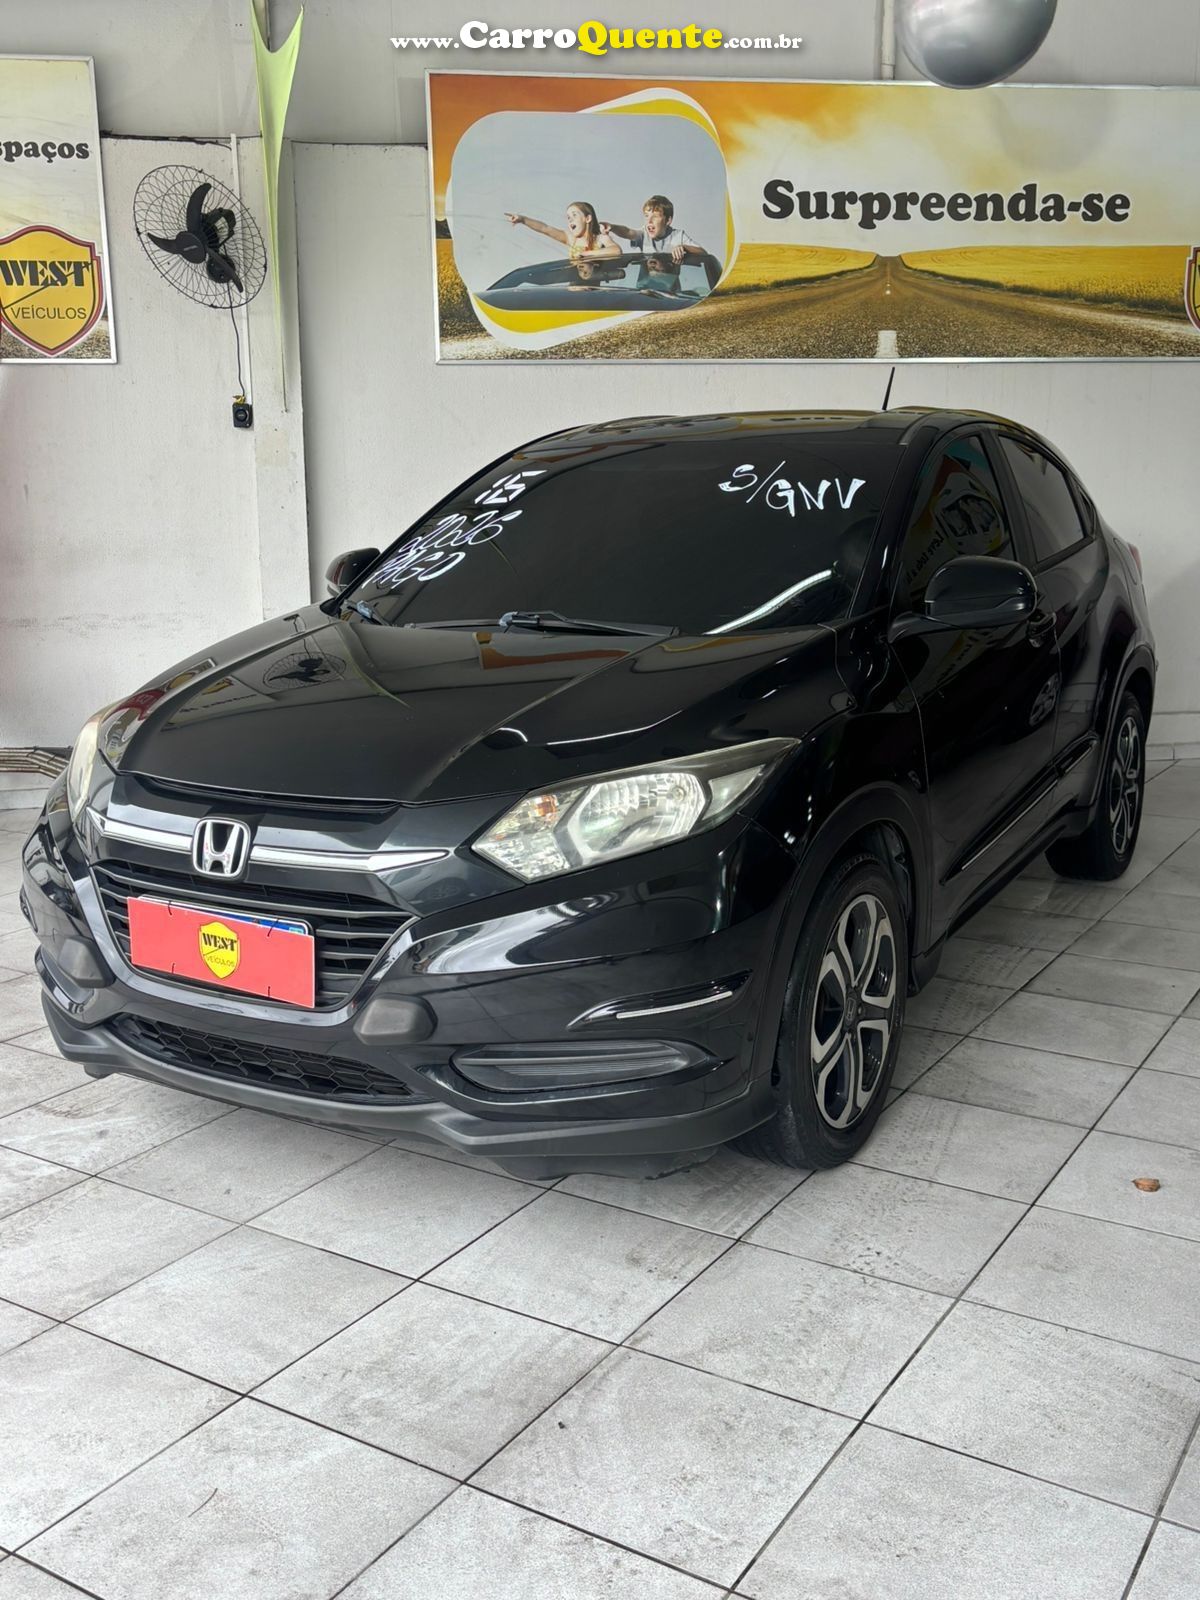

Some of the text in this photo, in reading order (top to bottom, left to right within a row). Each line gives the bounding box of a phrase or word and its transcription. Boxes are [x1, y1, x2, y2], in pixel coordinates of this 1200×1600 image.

[762, 179, 1131, 230] Surpreenda-se
[0, 259, 92, 287] WEST
[10, 305, 87, 320] VEÍCULOS
[202, 932, 237, 952] WEST
